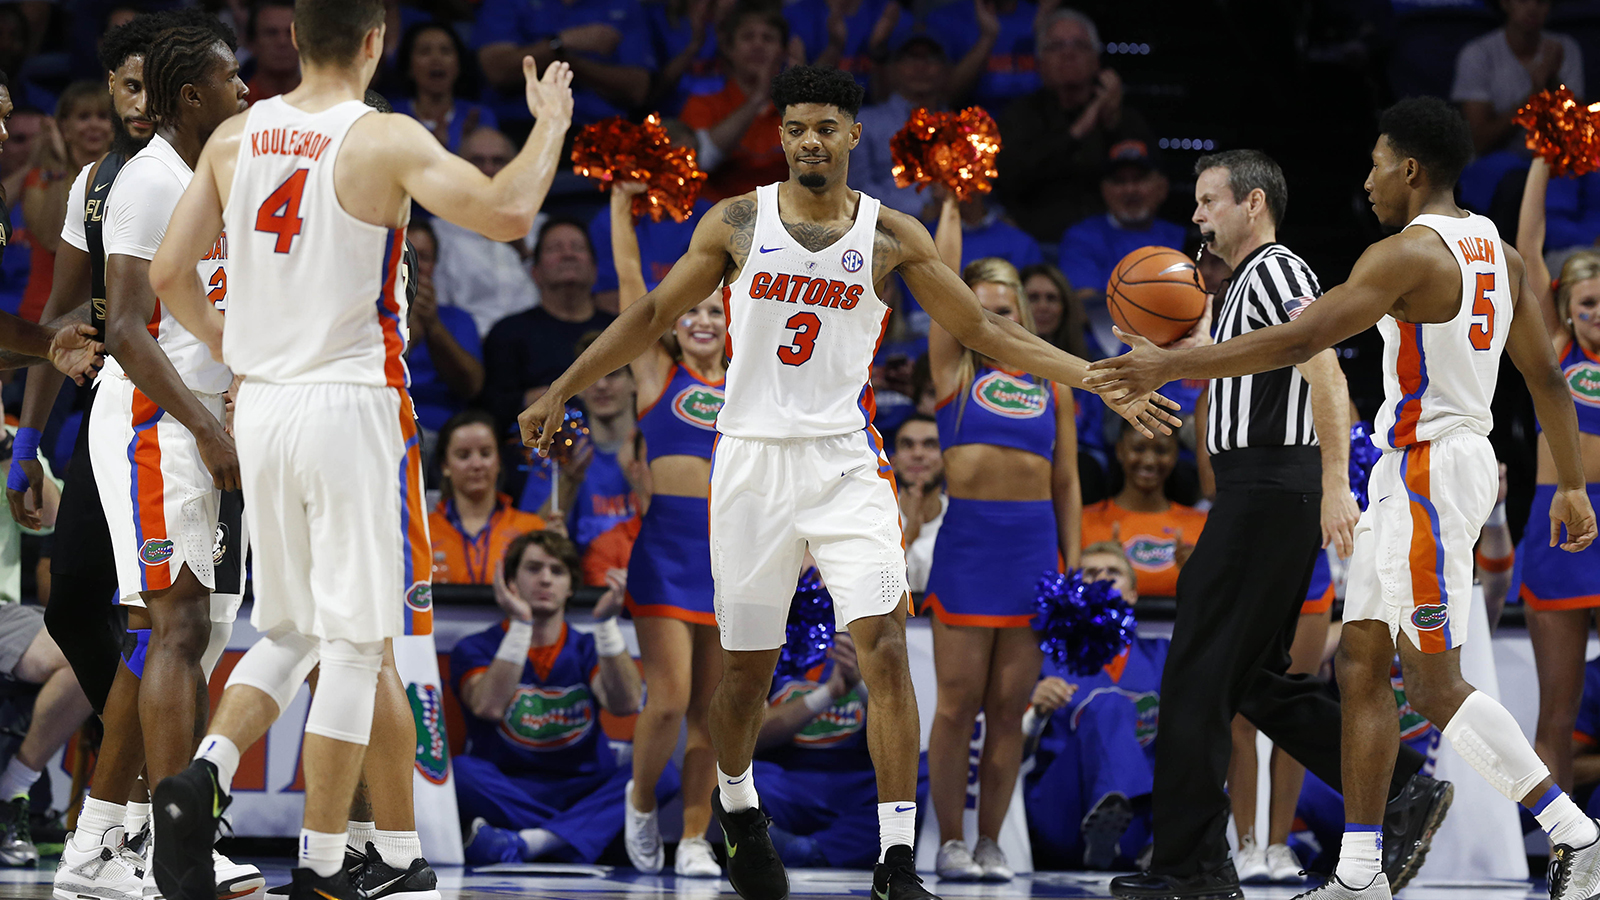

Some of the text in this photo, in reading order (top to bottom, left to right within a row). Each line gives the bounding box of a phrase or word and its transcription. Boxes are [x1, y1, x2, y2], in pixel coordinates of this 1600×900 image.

[254, 168, 310, 254] 4
[843, 250, 862, 271] SEC
[1457, 236, 1496, 266] ALLEN
[749, 271, 865, 311] GATORS
[1468, 271, 1496, 351] 5
[776, 310, 823, 368] 3
